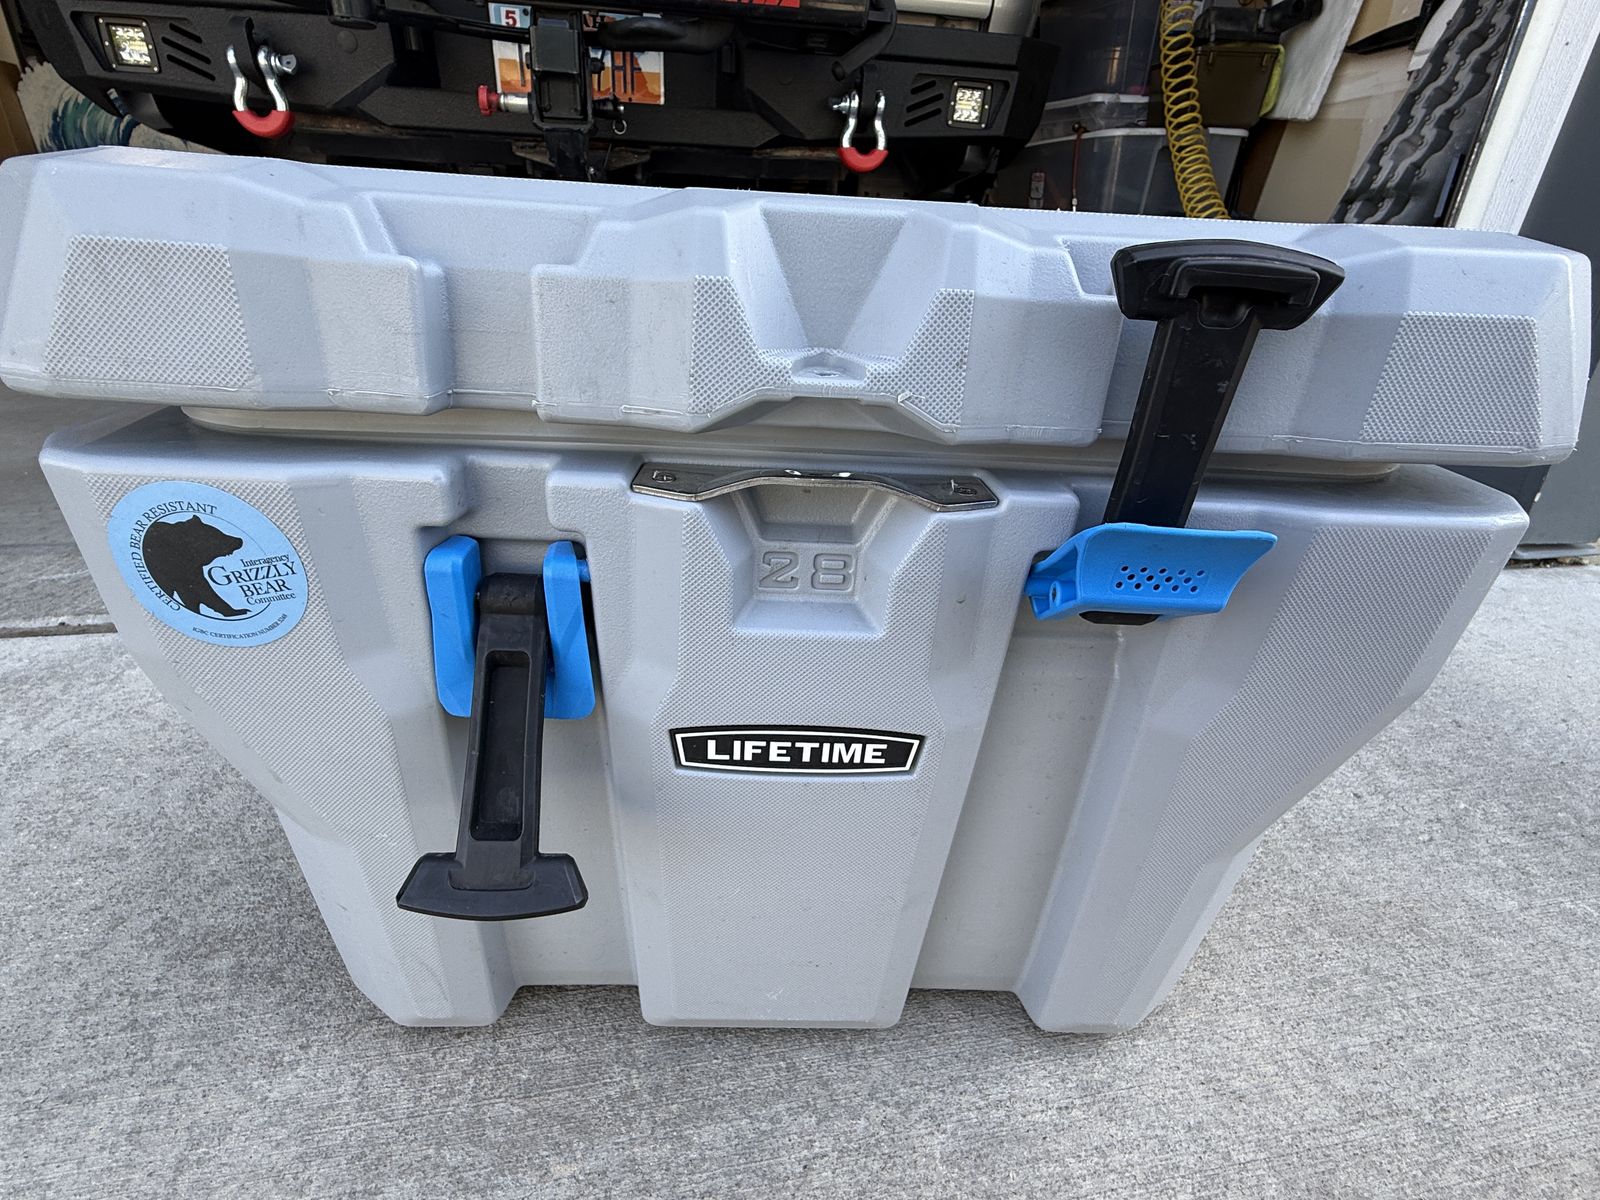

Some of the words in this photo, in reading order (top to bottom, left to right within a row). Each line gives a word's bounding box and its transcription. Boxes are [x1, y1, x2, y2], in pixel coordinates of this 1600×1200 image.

[142, 500, 218, 522] RESISTANT
[129, 520, 149, 551] BEAR
[240, 554, 290, 568] Interagency
[757, 550, 858, 592] 28
[131, 552, 181, 612] CERTIFIED
[238, 579, 292, 598] BEAR
[246, 592, 297, 606] Committee
[209, 631, 259, 640] CERTIFICATION
[258, 622, 279, 637] NUMBER
[706, 739, 888, 765] LIFETIME
